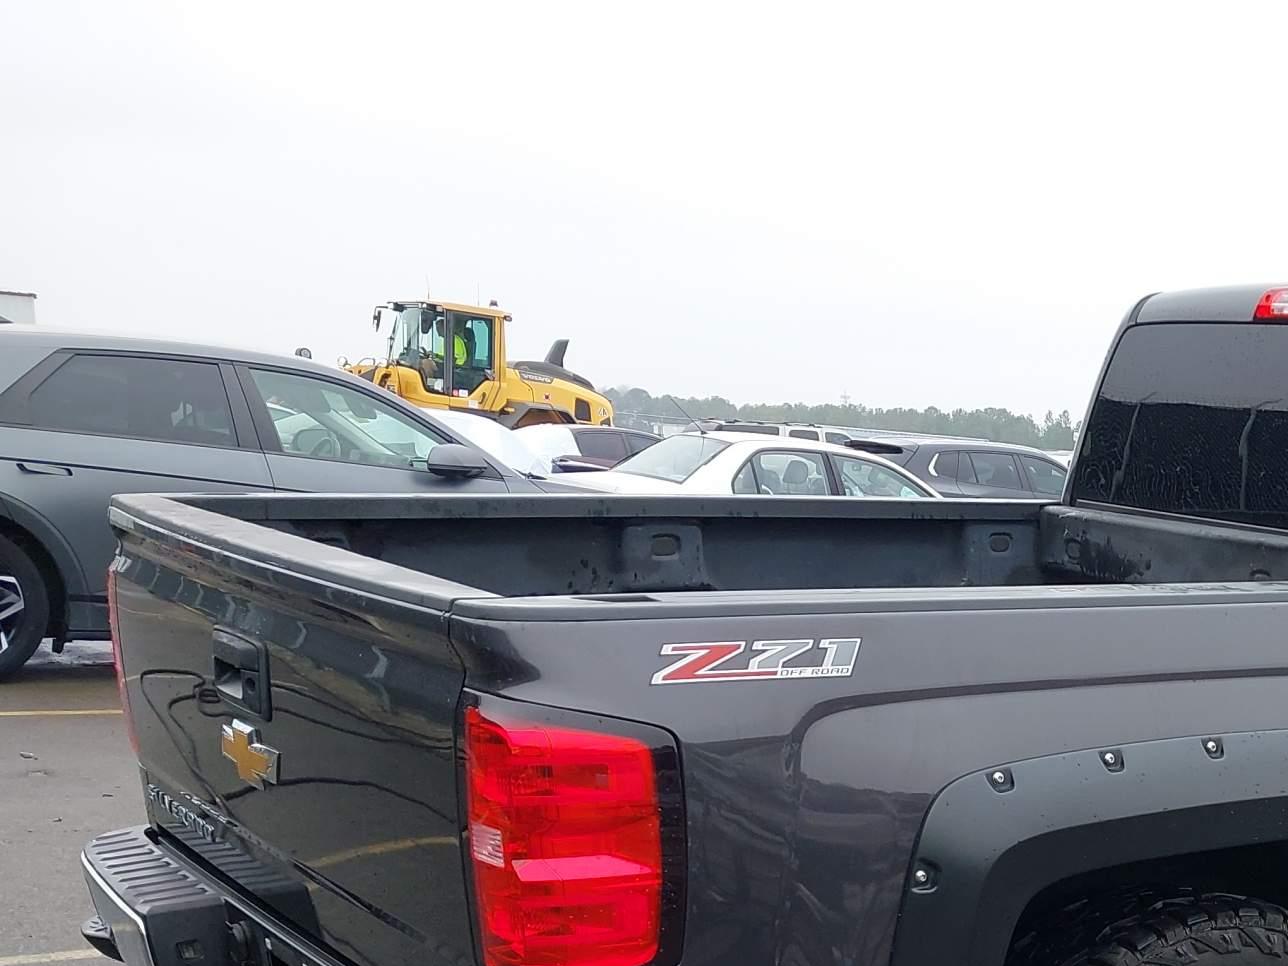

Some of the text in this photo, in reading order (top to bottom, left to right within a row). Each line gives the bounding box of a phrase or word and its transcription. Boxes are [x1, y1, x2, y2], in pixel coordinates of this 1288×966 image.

[521, 373, 551, 383] VOLVO
[649, 638, 862, 685] Z71
[780, 667, 850, 677] OFF ROAD
[147, 783, 215, 843] SILVERADO
